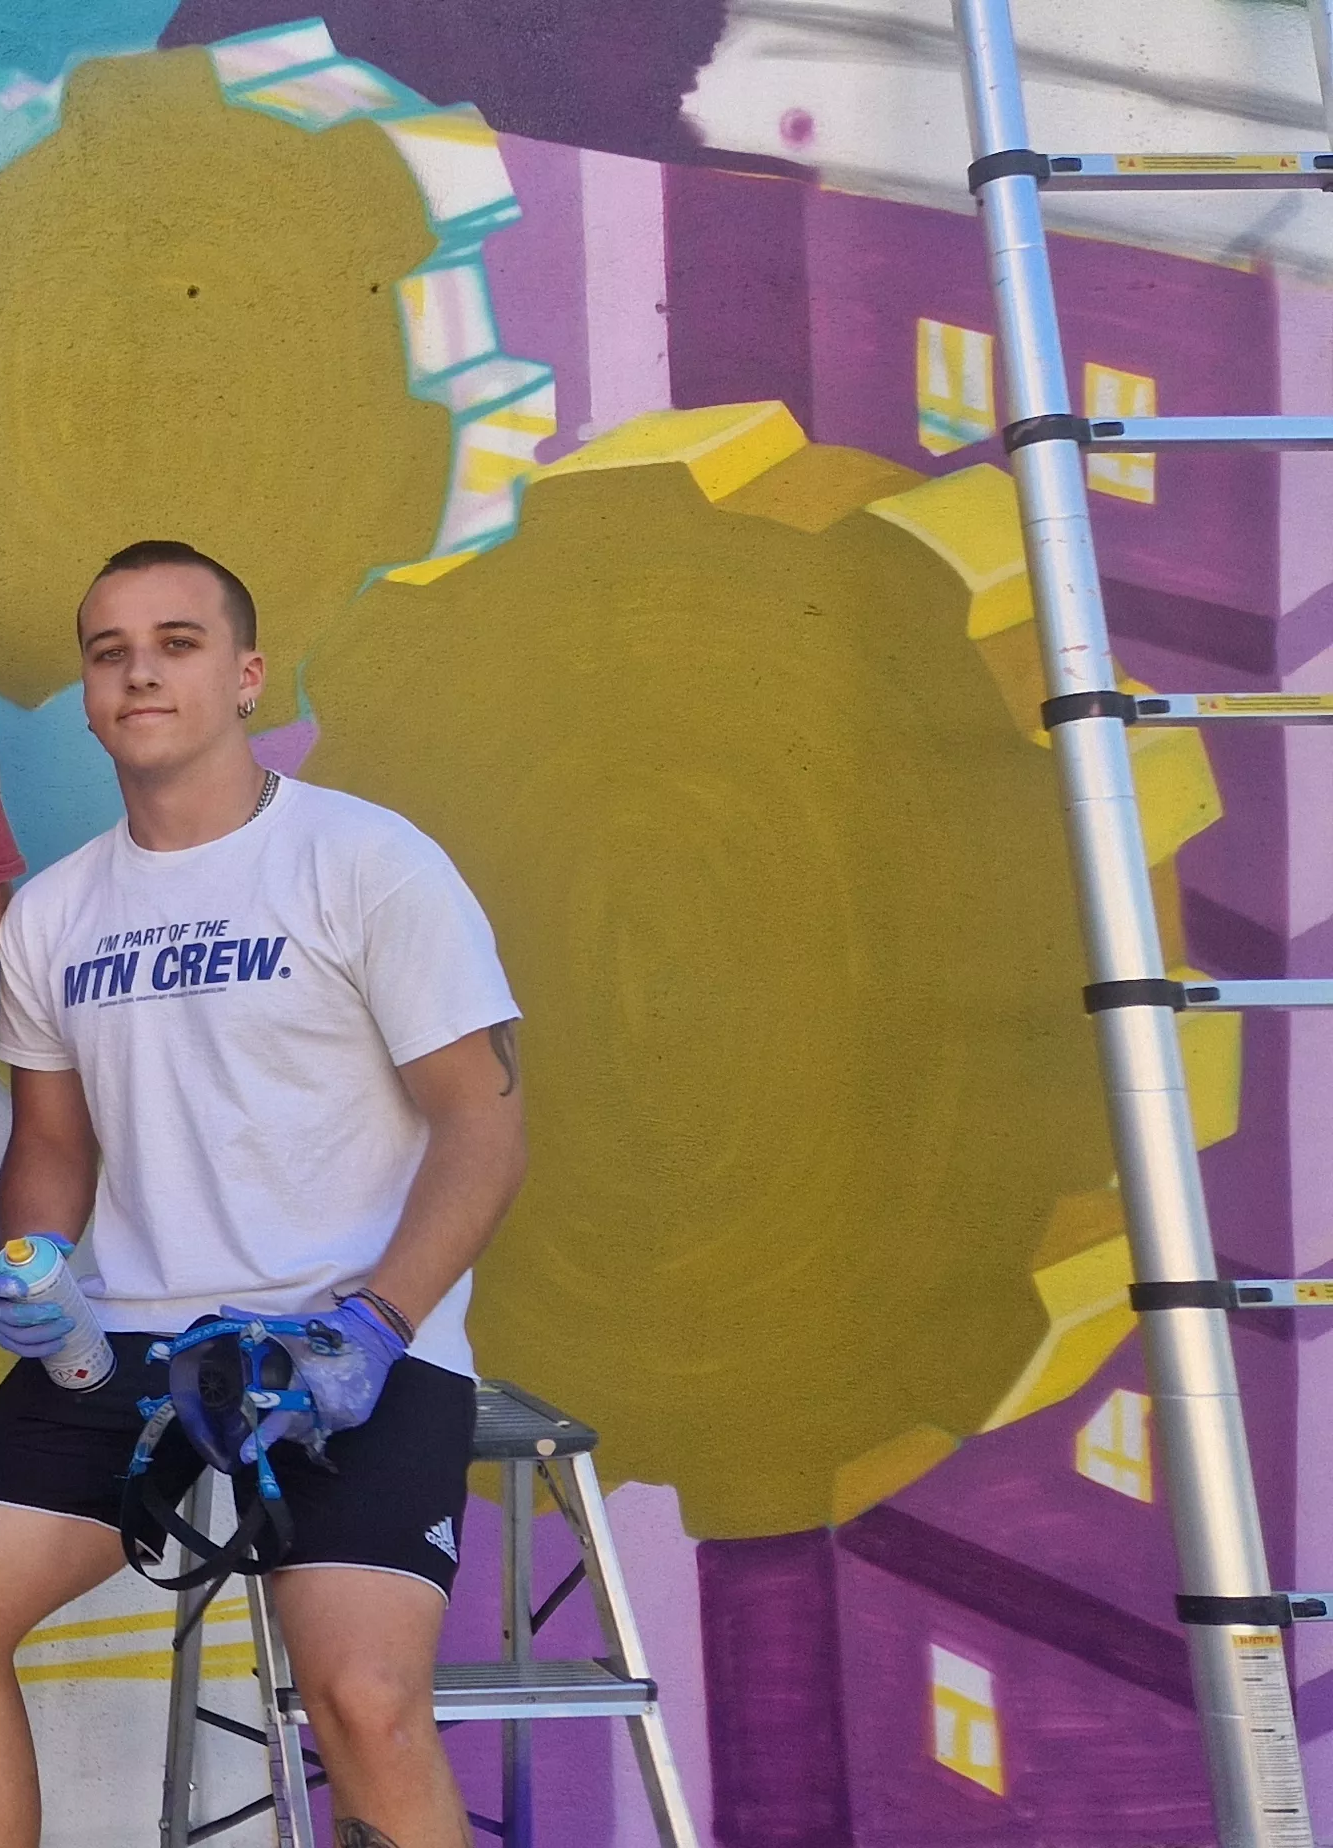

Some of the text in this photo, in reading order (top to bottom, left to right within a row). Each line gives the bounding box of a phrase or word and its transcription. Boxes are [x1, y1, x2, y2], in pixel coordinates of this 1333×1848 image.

[96, 919, 230, 955] I'M PART OF THE
[64, 951, 140, 1008] MTN
